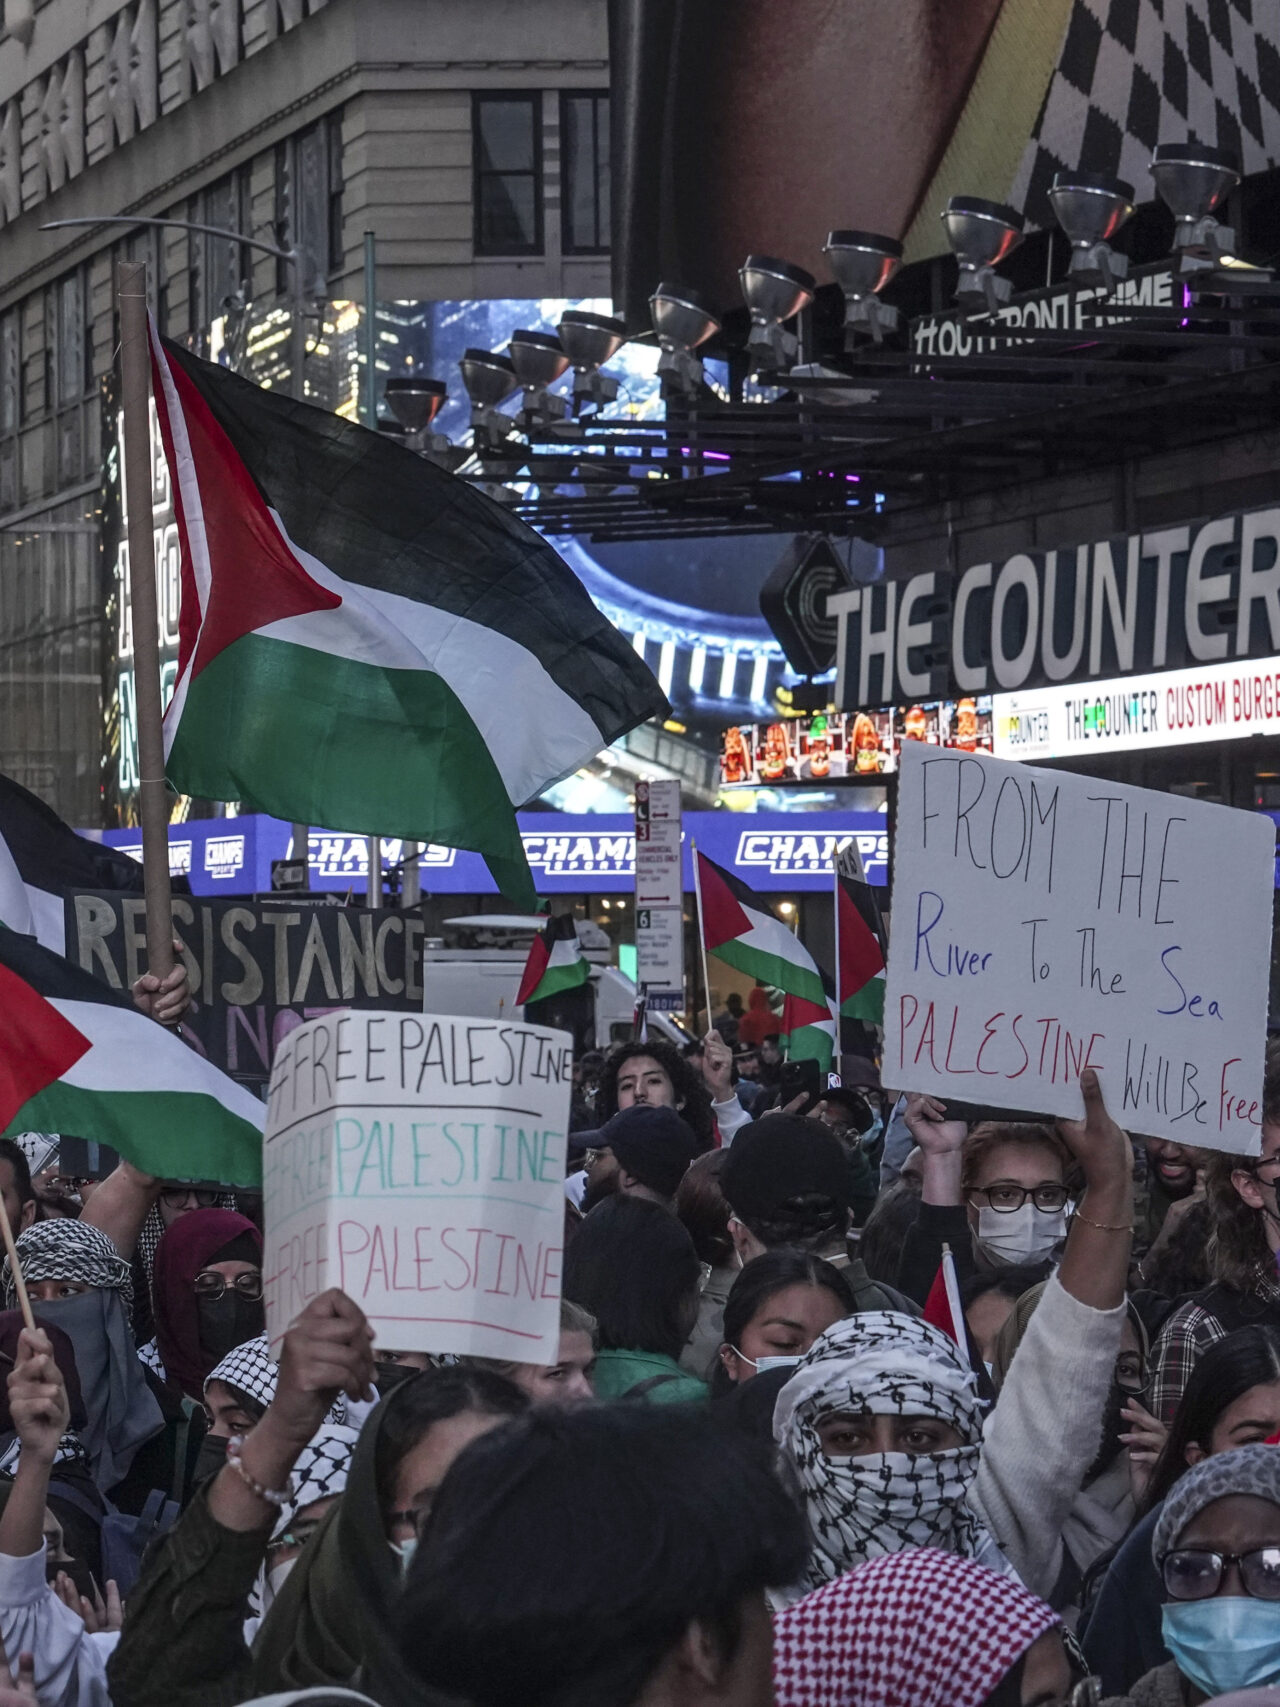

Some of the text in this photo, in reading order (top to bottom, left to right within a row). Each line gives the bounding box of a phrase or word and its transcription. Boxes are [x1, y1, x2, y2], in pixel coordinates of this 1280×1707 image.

[826, 508, 1280, 708] THE COUNTER
[1065, 699, 1089, 740] THE
[1095, 691, 1158, 738] COUNTER
[1166, 682, 1227, 731] CUSTOM
[922, 758, 1187, 924] FROM THE
[74, 894, 424, 1005] RESISTANCE
[1021, 919, 1050, 983] To
[1076, 928, 1126, 995] The
[1156, 946, 1224, 1020] Sea
[899, 995, 1263, 1132] PALESTINE Will Be Free
